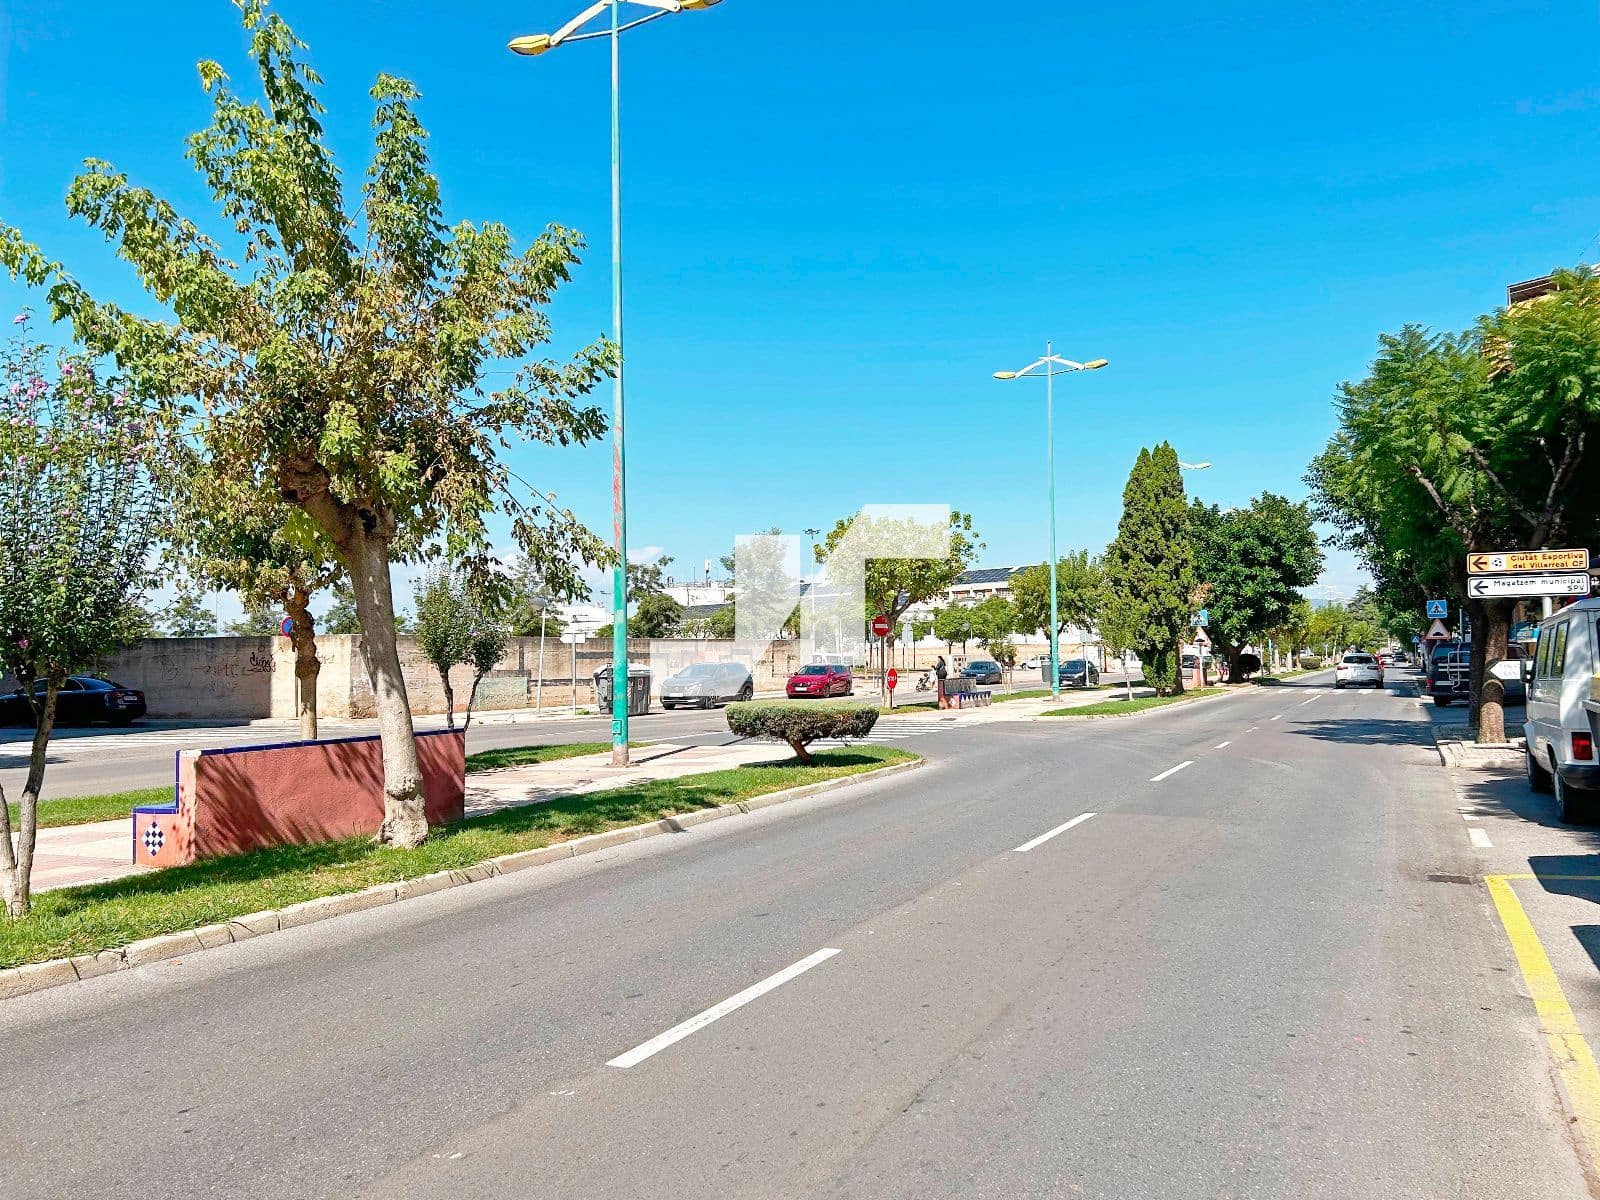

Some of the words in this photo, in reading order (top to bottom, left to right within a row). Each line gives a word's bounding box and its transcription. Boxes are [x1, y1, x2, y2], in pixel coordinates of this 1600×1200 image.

[1493, 579, 1537, 587] Magatzem
[1541, 577, 1584, 585] municipal
[1567, 584, 1584, 592] SPV
